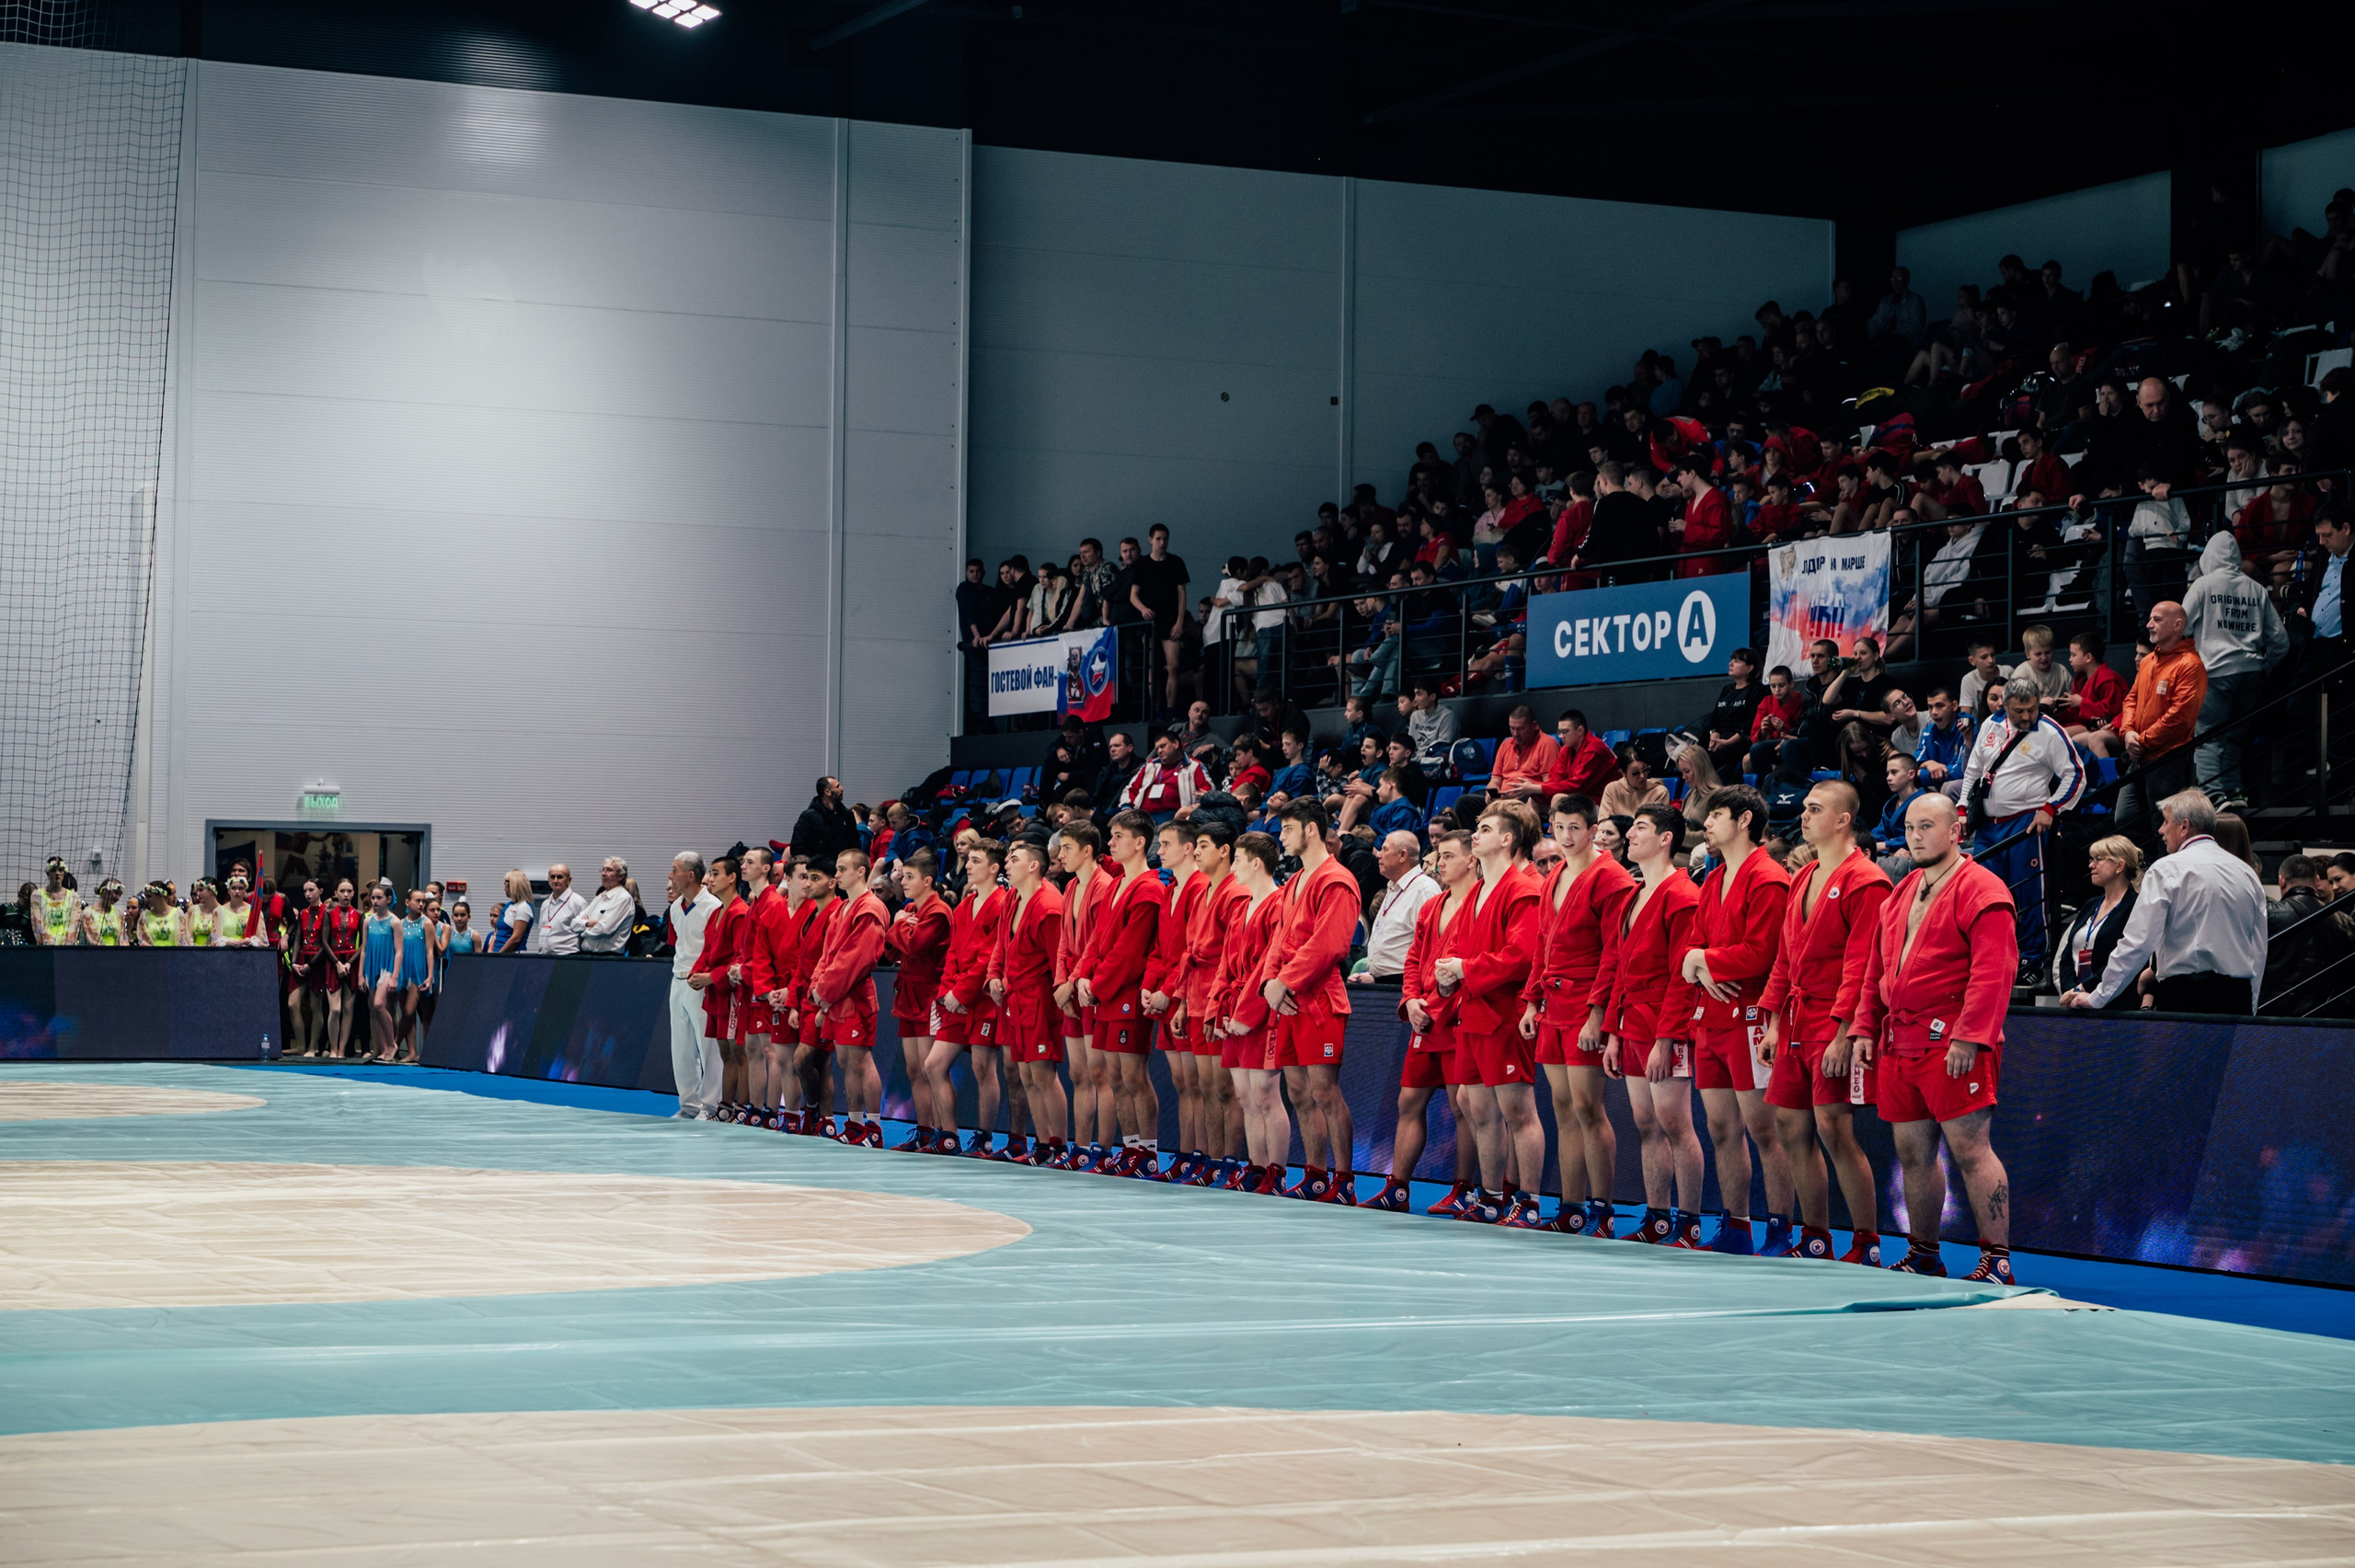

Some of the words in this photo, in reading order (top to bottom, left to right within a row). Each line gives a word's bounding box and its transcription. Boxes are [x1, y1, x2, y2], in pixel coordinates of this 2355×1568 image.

[1841, 555, 1866, 571] МАРШЕ
[2224, 607, 2248, 619] FROM
[2217, 619, 2257, 632] NOWHERE
[1554, 611, 1671, 658] СЕКТОР
[991, 663, 1032, 693] ГОСТЕВОЙ
[1034, 665, 1057, 688] ФАН-
